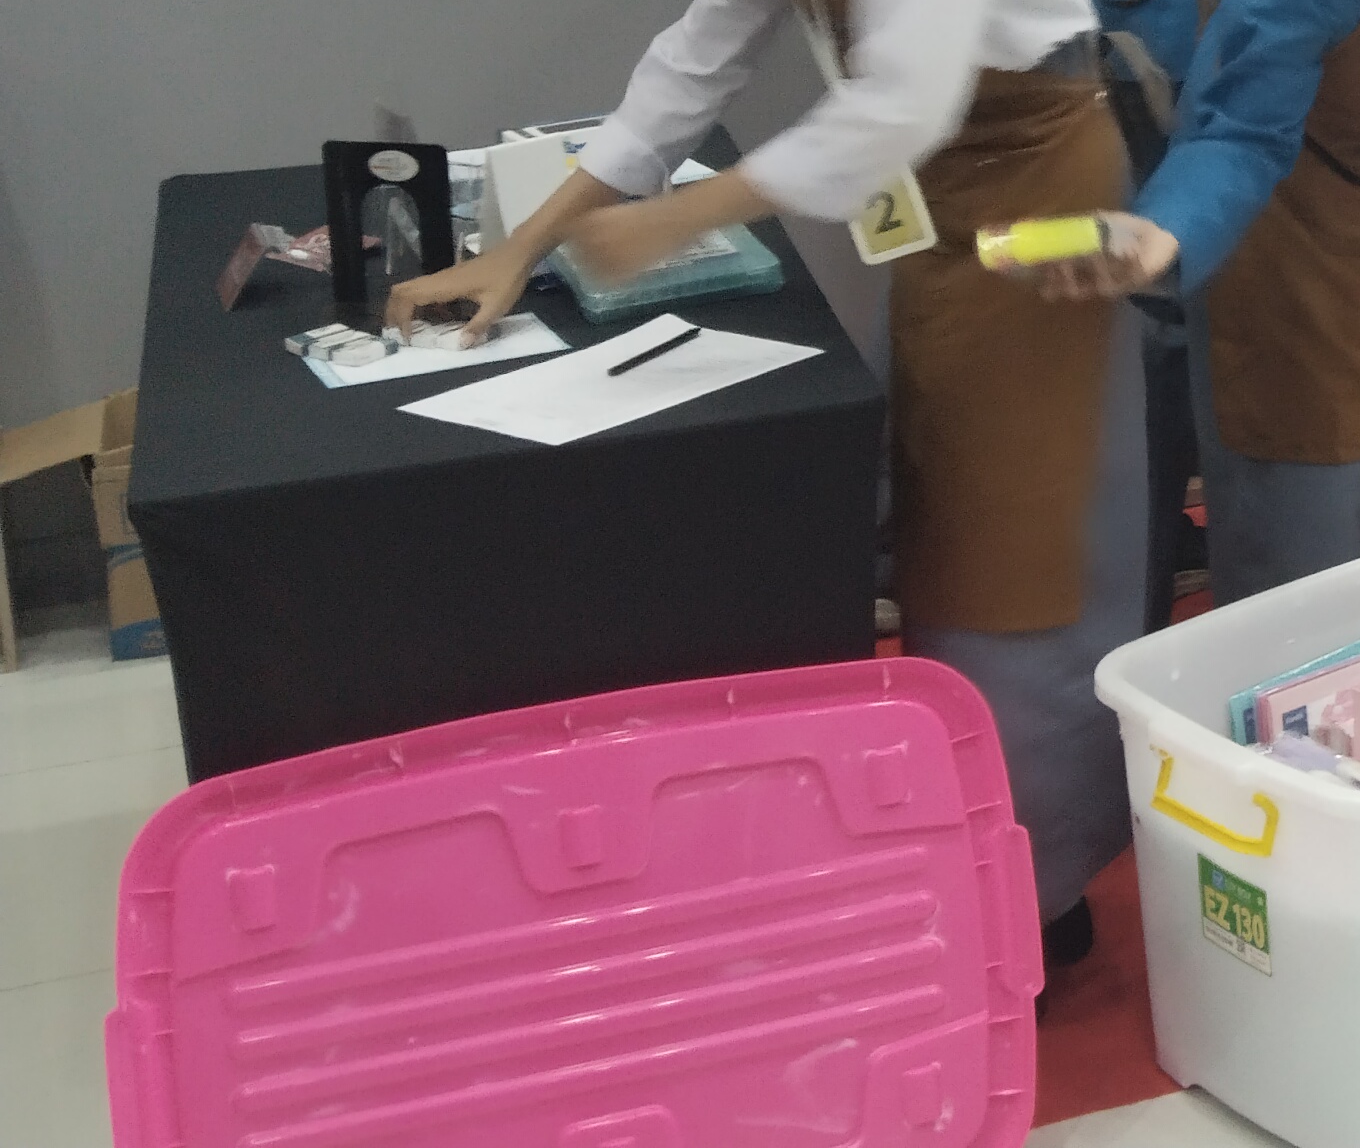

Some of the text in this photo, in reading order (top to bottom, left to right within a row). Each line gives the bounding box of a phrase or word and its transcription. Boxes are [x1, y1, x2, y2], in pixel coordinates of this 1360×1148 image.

[864, 190, 904, 235] 2
[1203, 884, 1231, 931] EZ
[1232, 903, 1266, 950] 130
